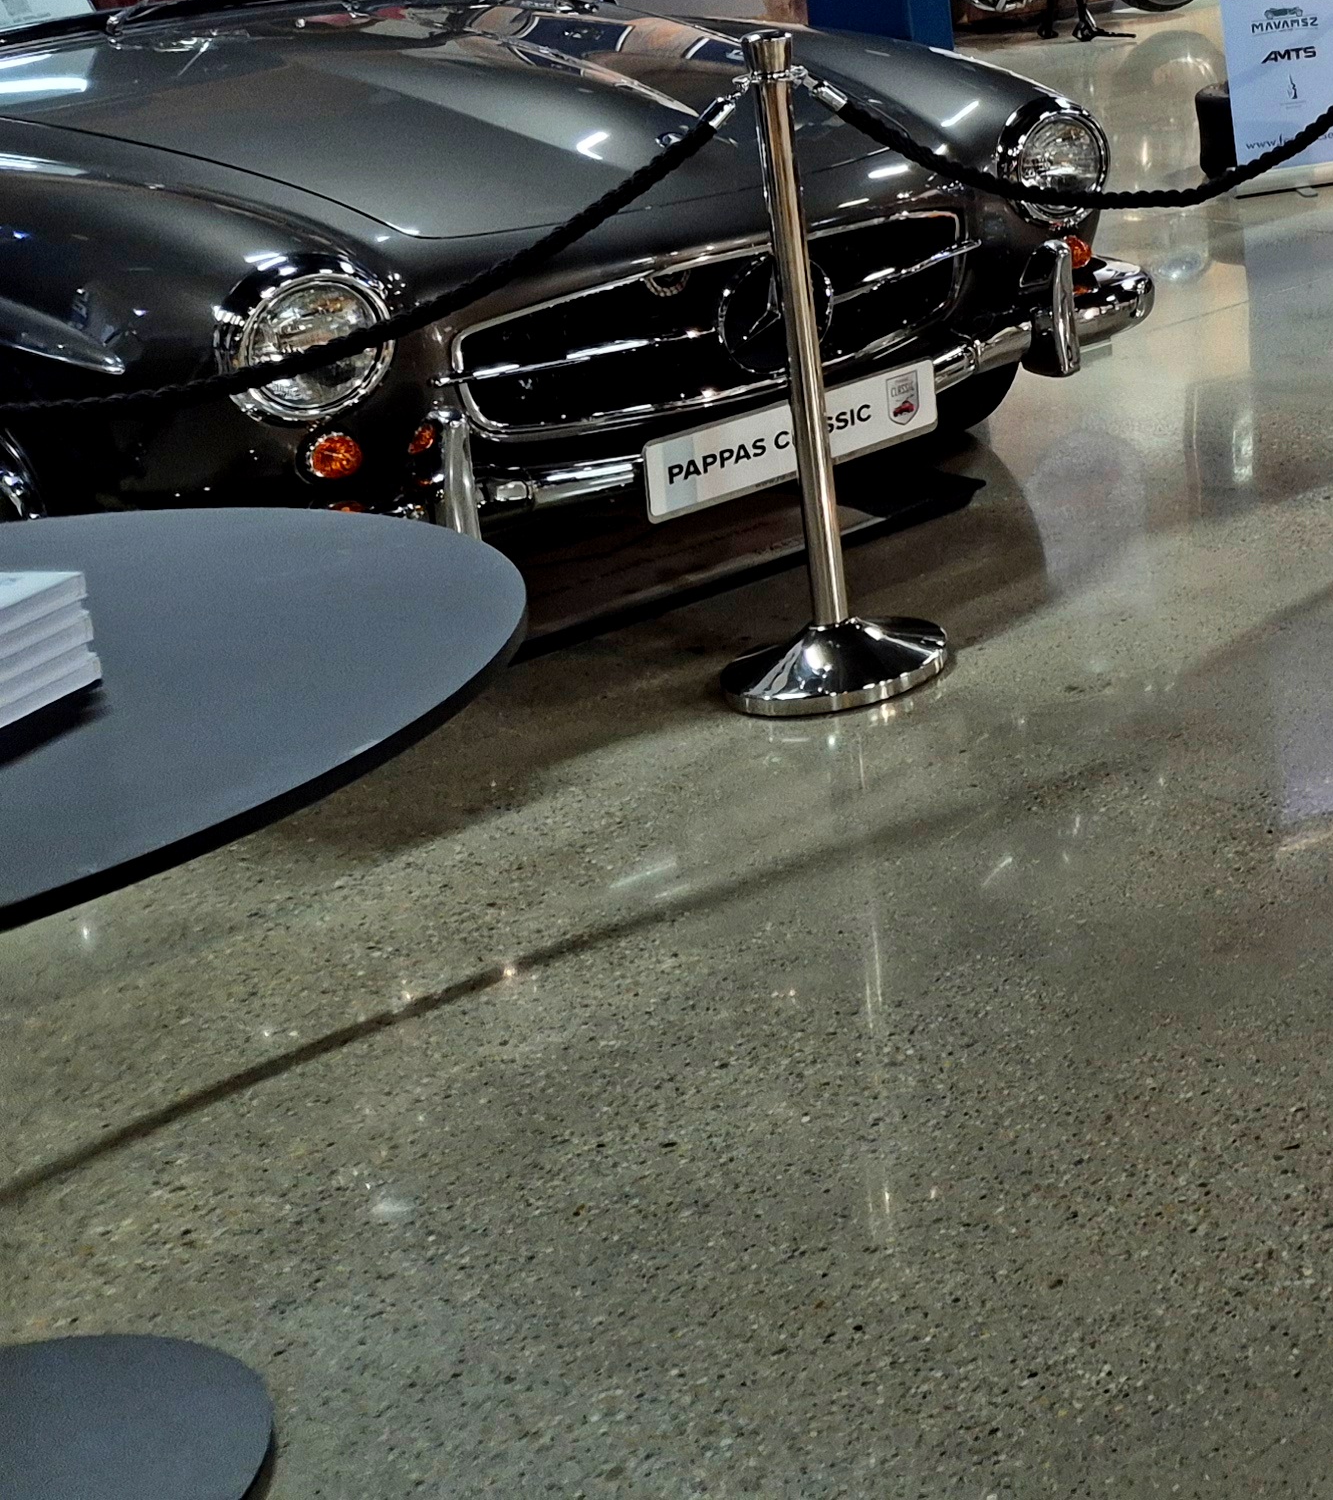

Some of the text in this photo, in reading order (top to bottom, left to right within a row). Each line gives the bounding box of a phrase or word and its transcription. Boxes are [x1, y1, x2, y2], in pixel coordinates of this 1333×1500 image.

[1251, 16, 1319, 34] MAVAMSZ
[1261, 45, 1317, 65] AMTS
[666, 402, 872, 486] PAPPAS CSSIC
